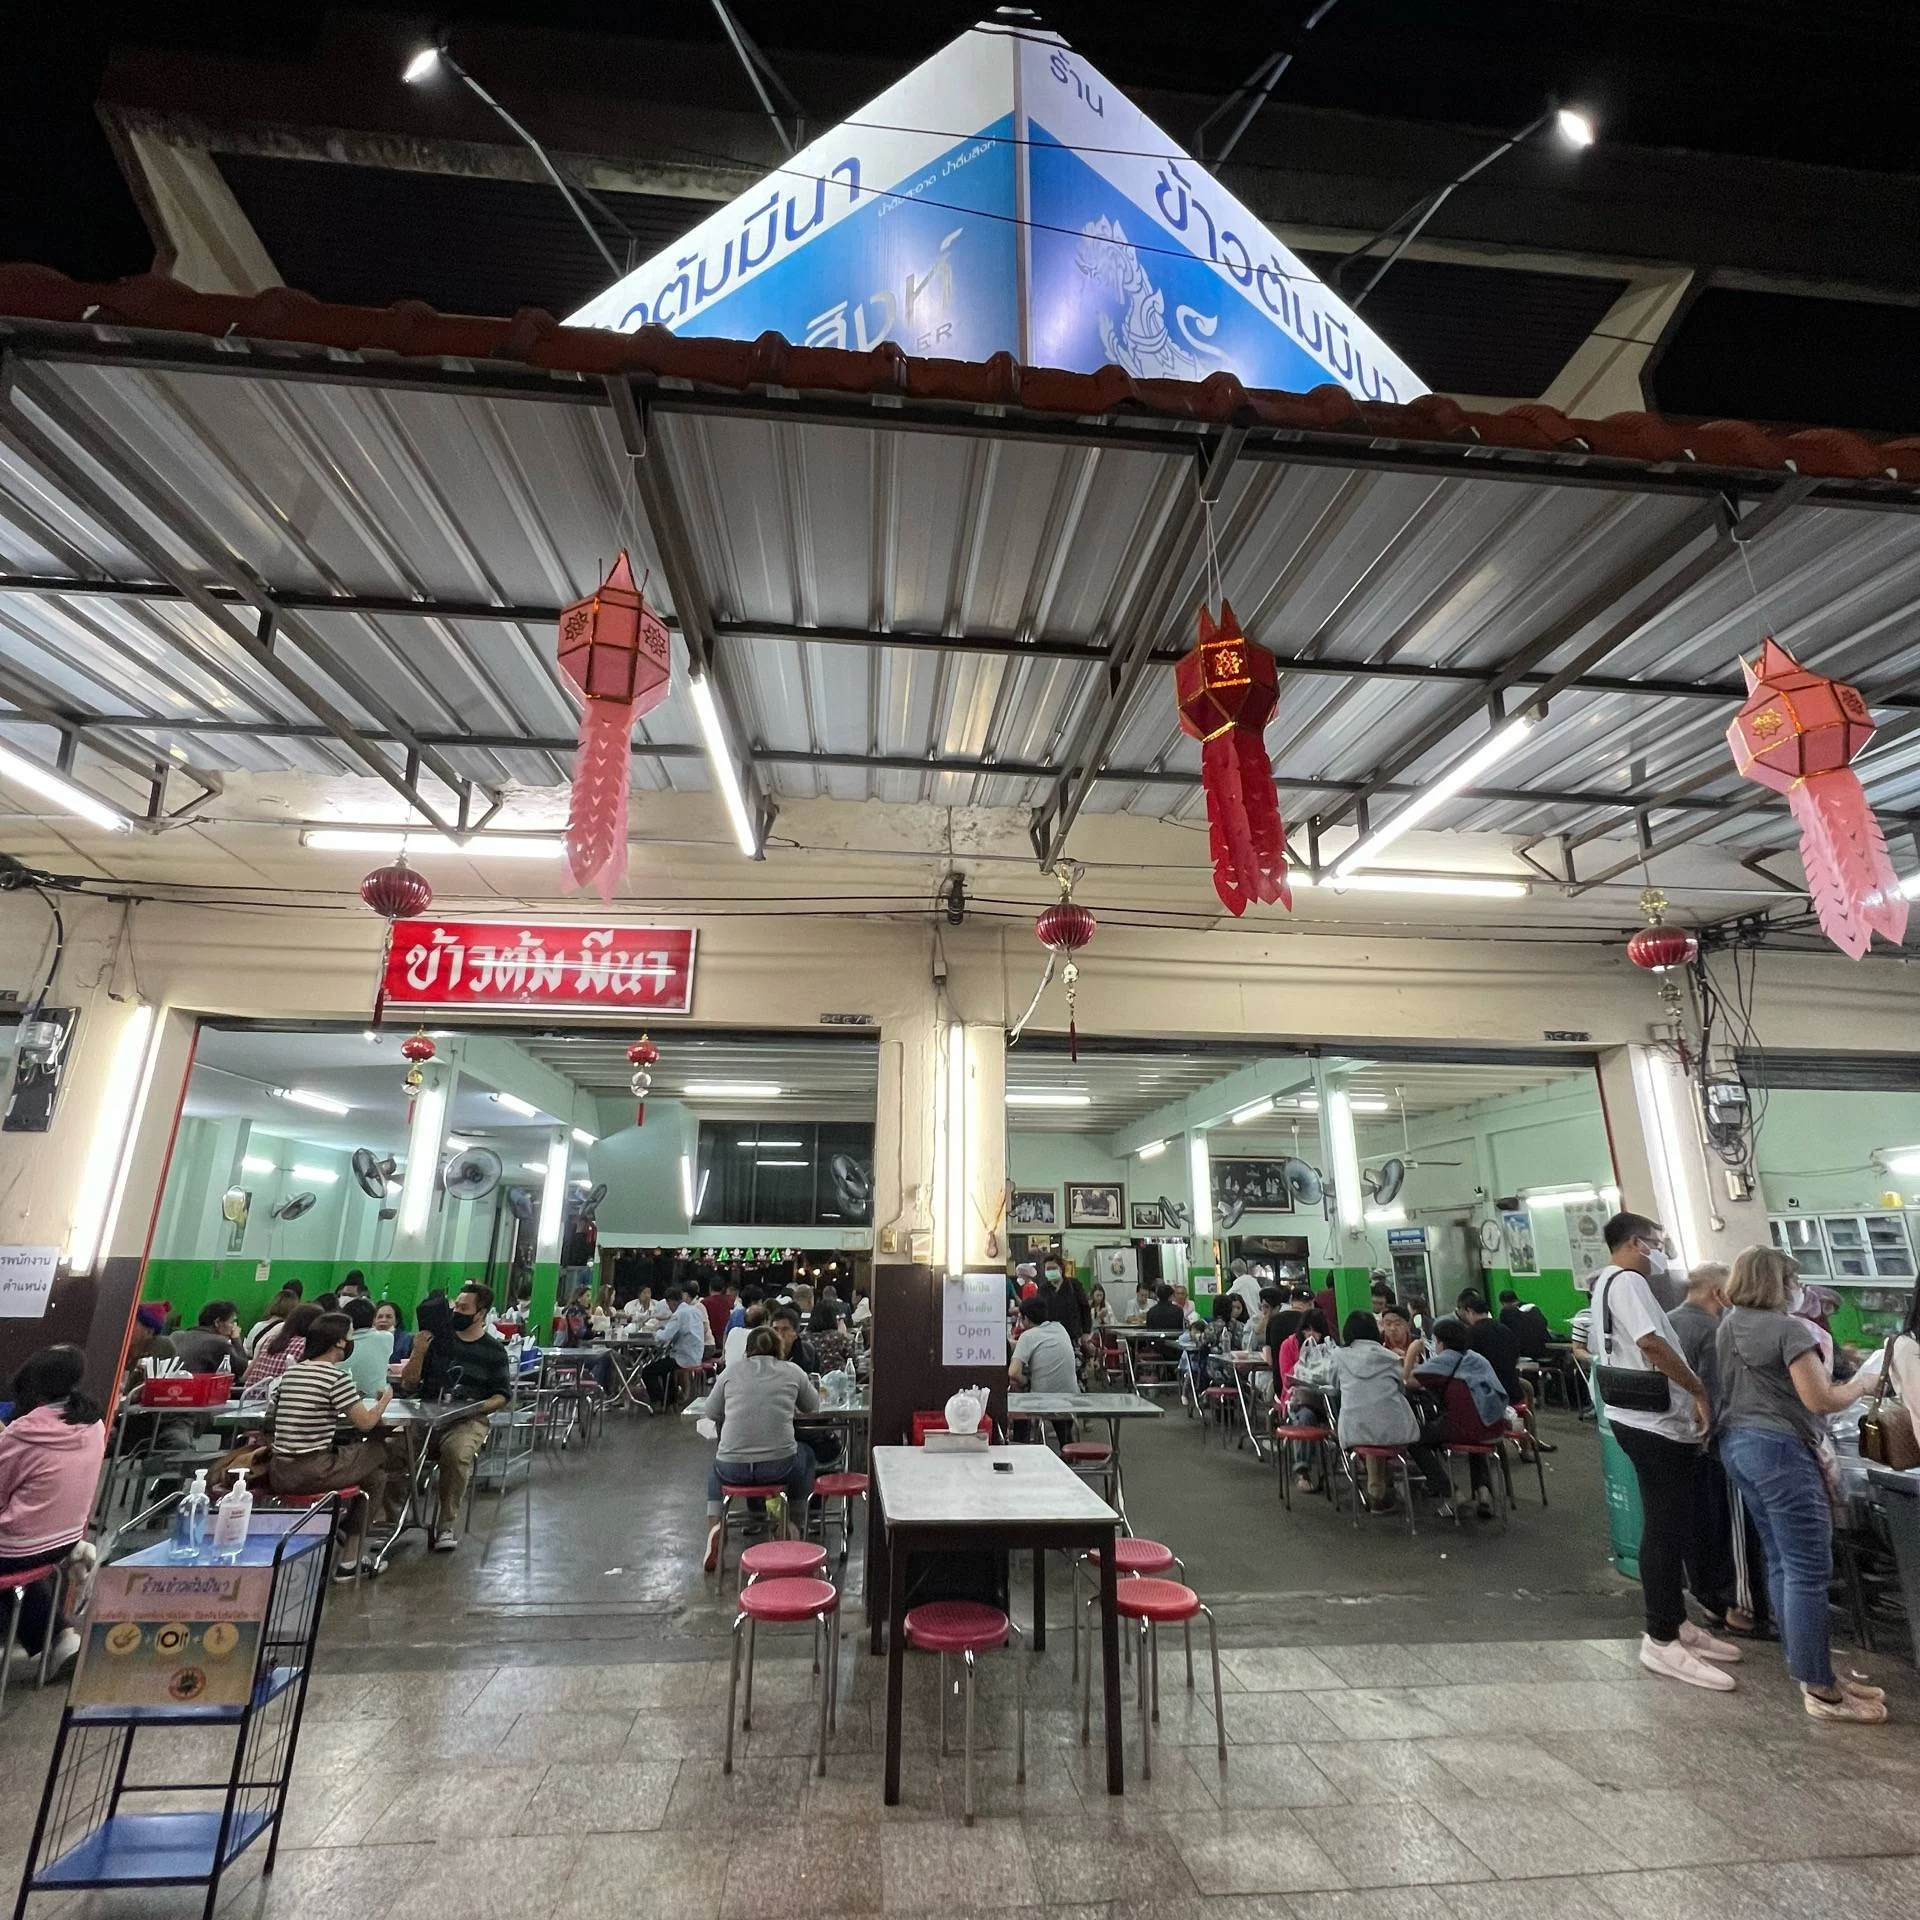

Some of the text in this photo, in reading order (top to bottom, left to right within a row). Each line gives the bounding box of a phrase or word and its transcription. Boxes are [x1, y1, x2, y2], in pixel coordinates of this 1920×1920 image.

[1050, 49, 1104, 118] ร้าน
[588, 157, 860, 330] วต้มมีนา
[405, 927, 671, 996] ข้าวต้ม มีนา
[955, 1347, 996, 1361] 5 P.M.
[957, 1323, 991, 1339] Open
